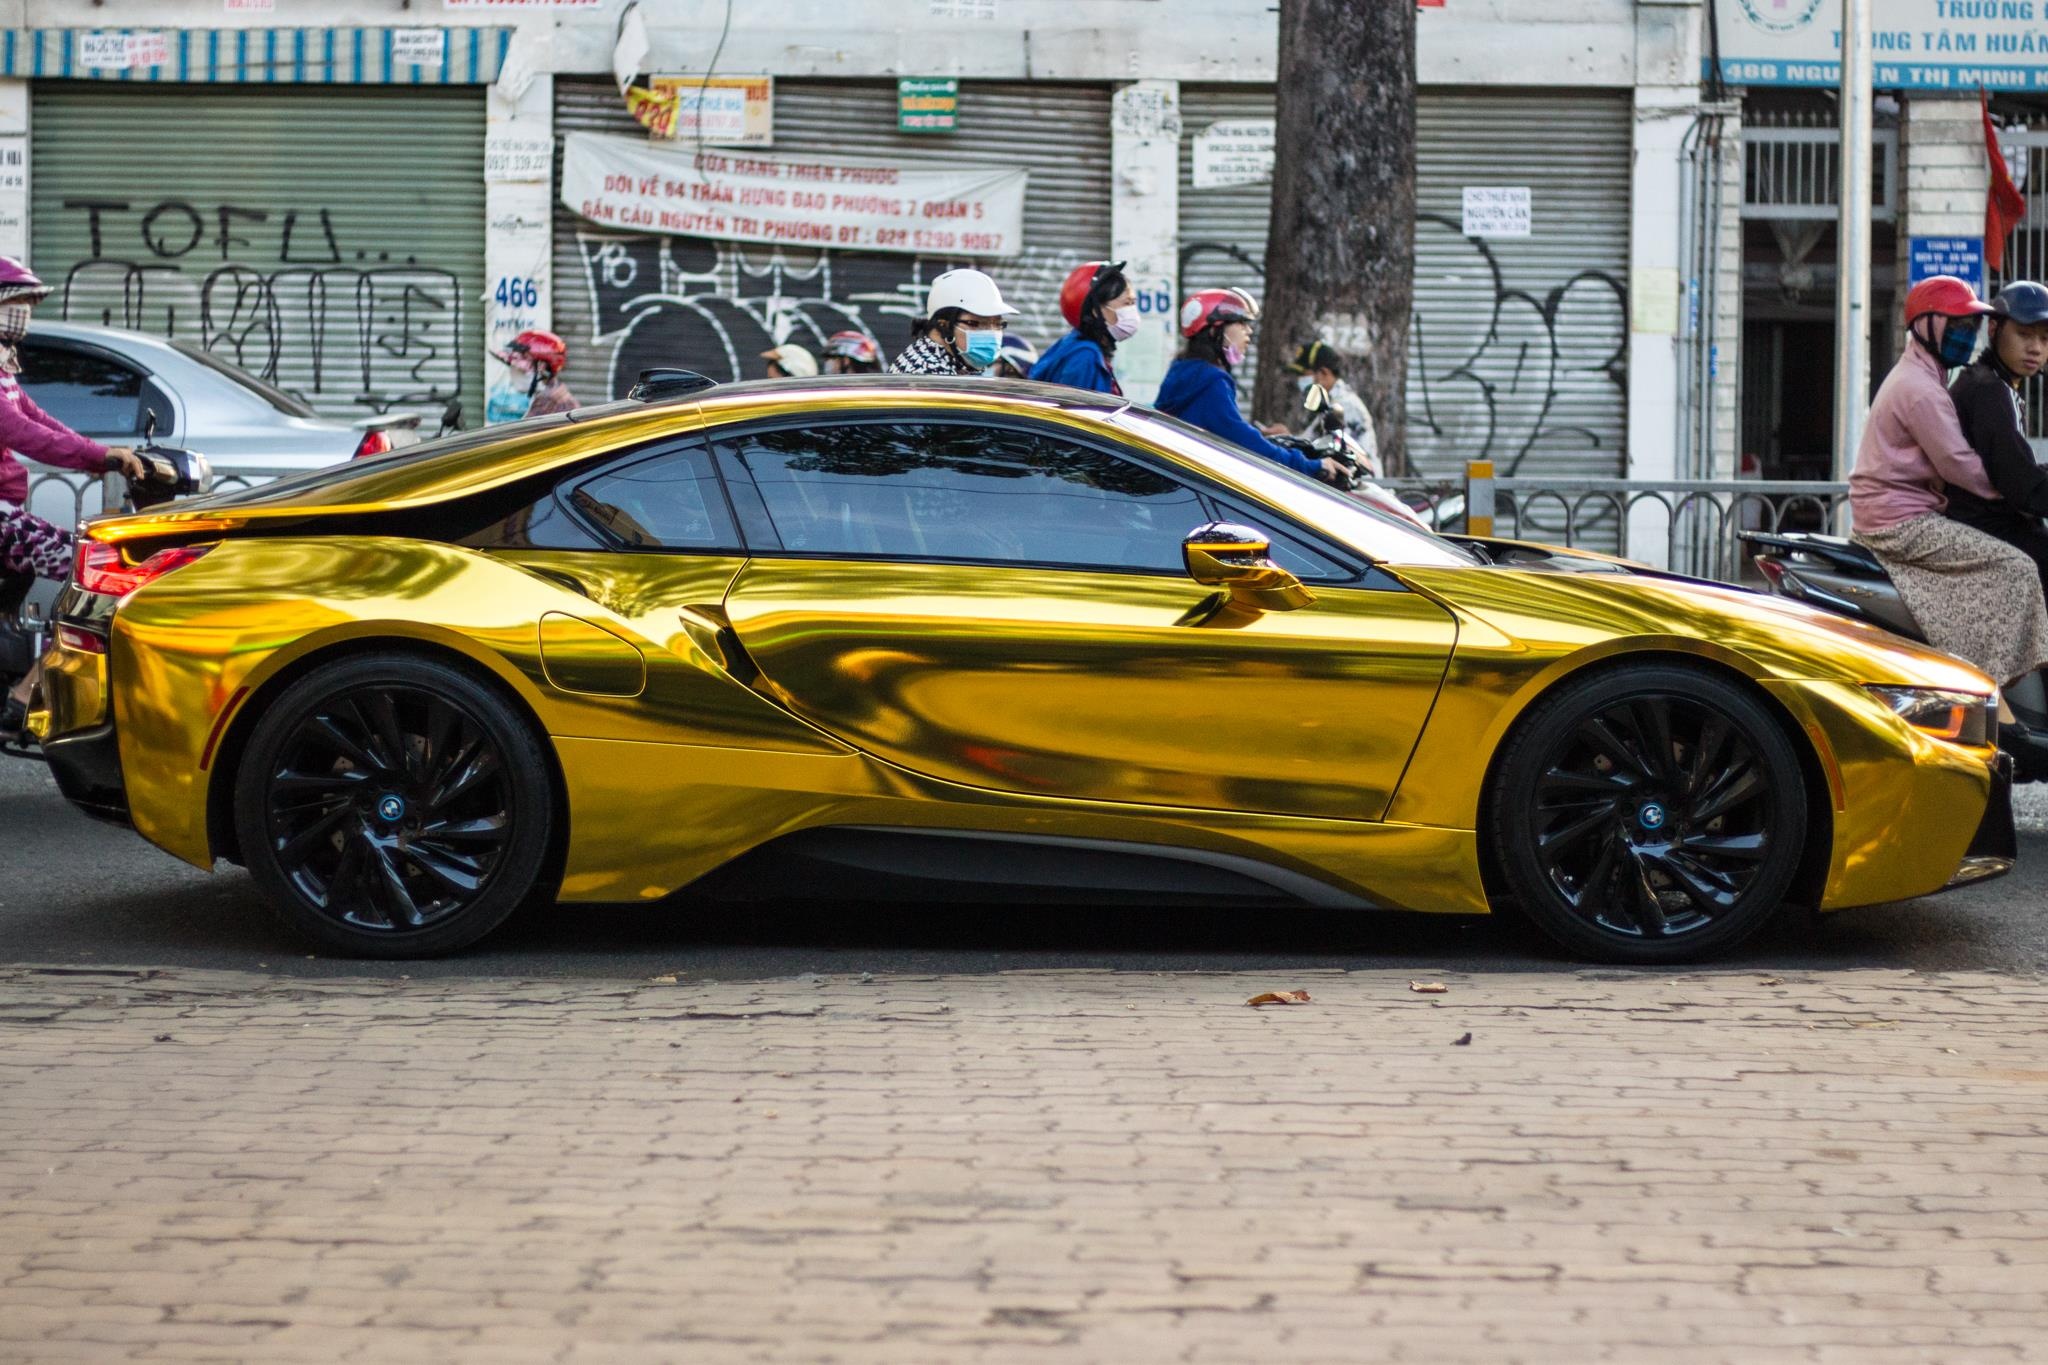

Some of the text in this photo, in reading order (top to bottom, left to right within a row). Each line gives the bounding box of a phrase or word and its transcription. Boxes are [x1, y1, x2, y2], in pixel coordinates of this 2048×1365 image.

[1922, 28, 1976, 52] TÂM
[1908, 68, 1950, 87] THỊ
[1957, 68, 2026, 86] MINH
[496, 276, 537, 308] 466
[1137, 279, 1170, 313] 66
